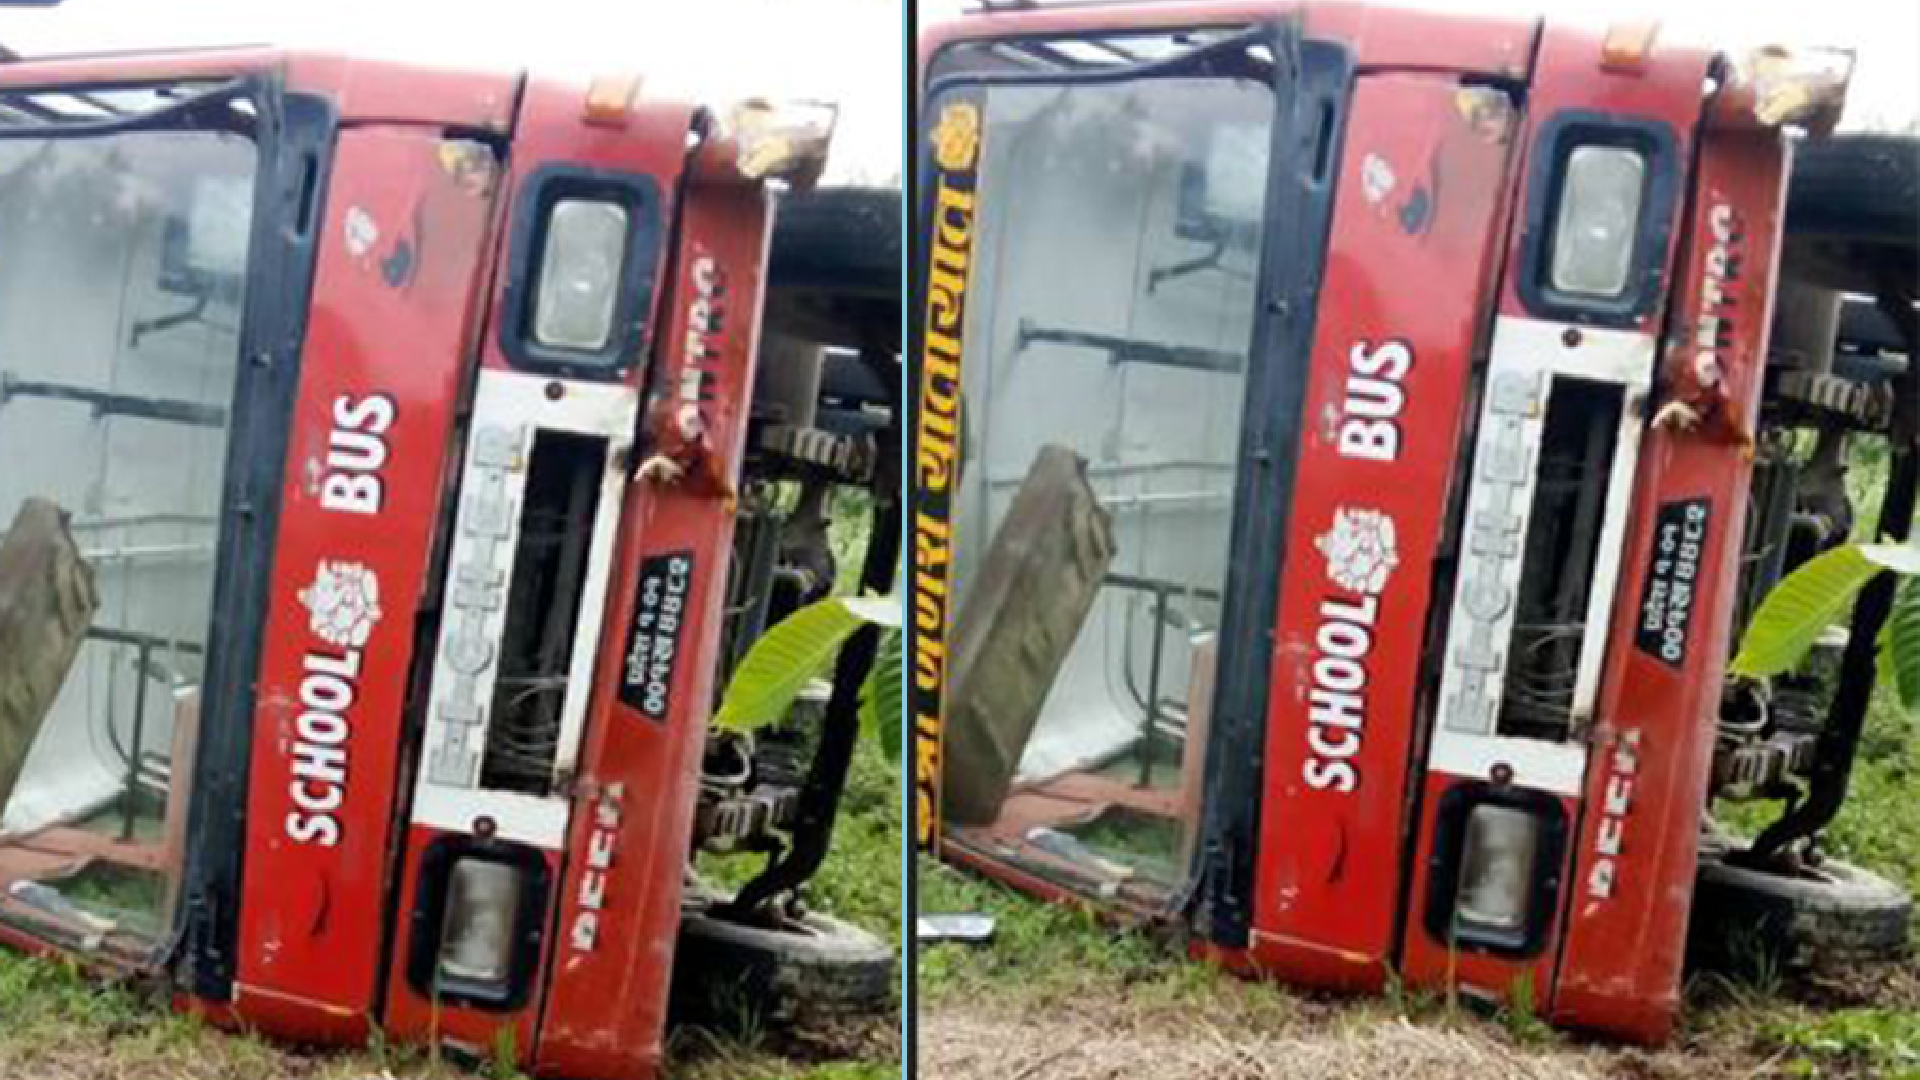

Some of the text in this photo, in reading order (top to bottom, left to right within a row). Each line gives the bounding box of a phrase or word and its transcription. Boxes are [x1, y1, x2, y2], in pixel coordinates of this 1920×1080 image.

[917, 182, 974, 490] यातायात
[286, 394, 394, 846] SCHOOL BUS
[1303, 340, 1411, 794] SCHOOL BUS
